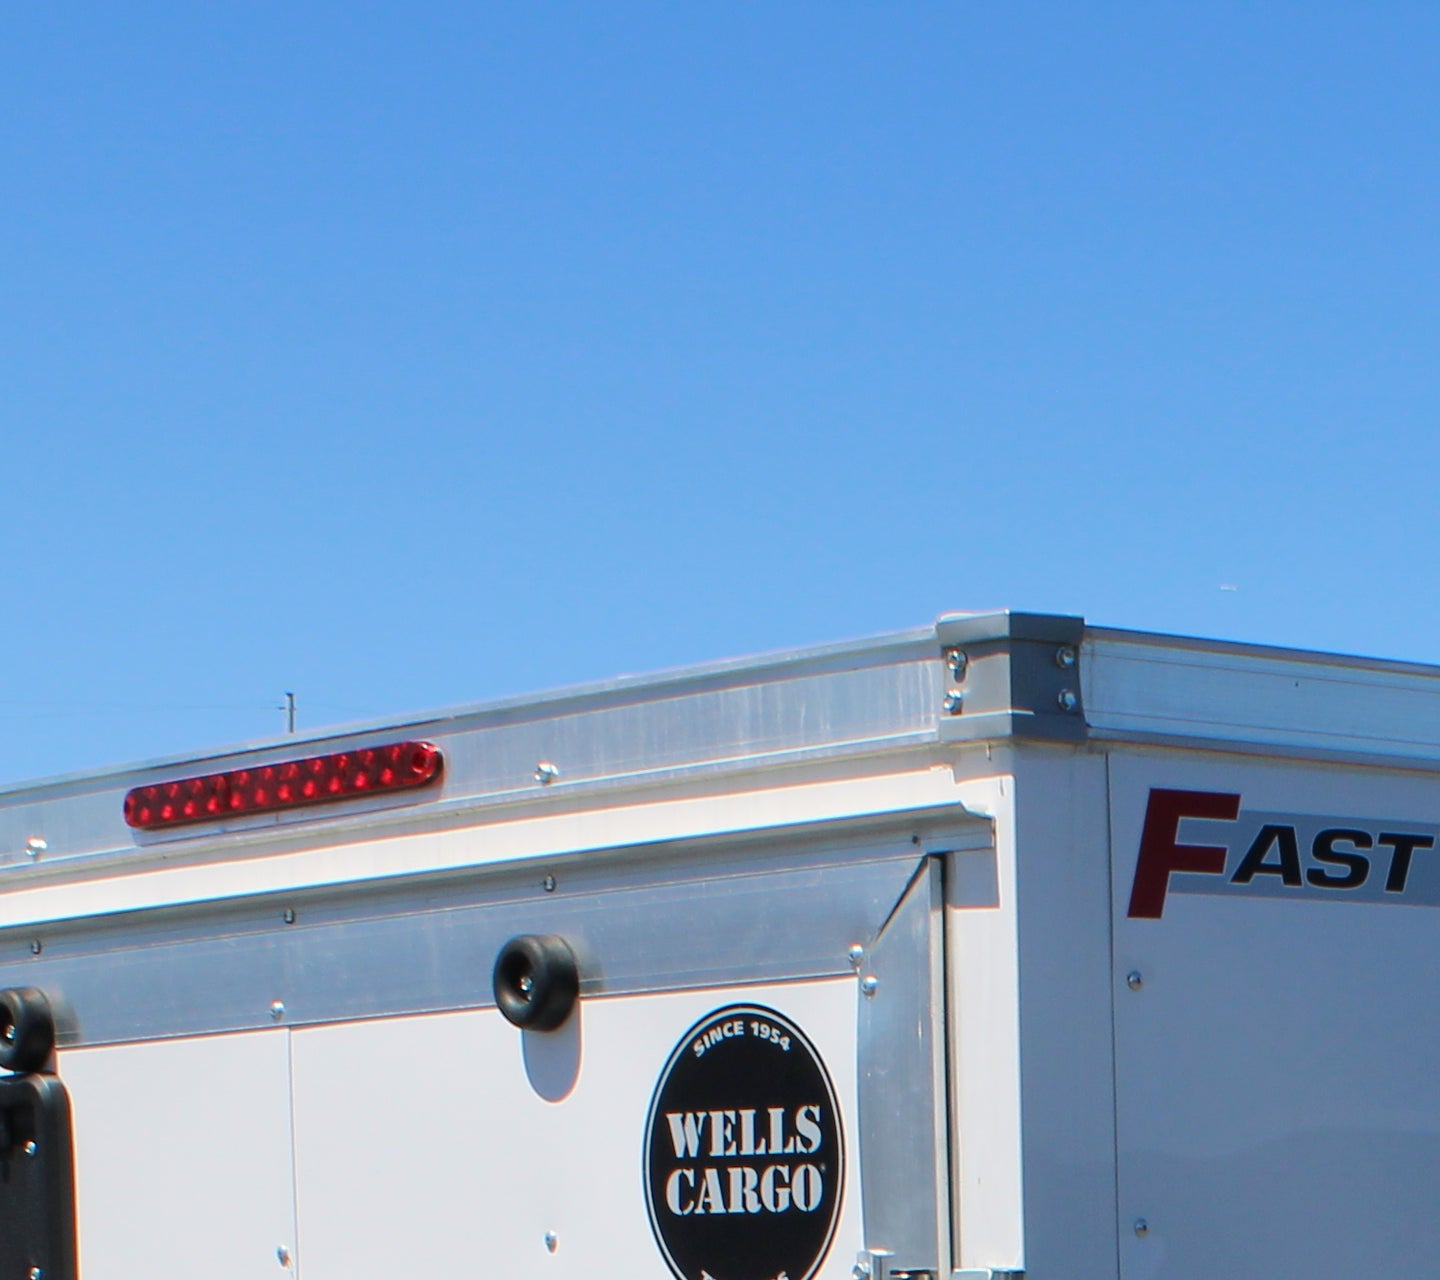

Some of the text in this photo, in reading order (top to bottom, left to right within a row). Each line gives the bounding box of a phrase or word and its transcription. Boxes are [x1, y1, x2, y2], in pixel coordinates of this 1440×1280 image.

[693, 1020, 791, 1058] SINCE 1954
[666, 1104, 822, 1159] WELLS
[666, 1163, 823, 1216] CARGO
